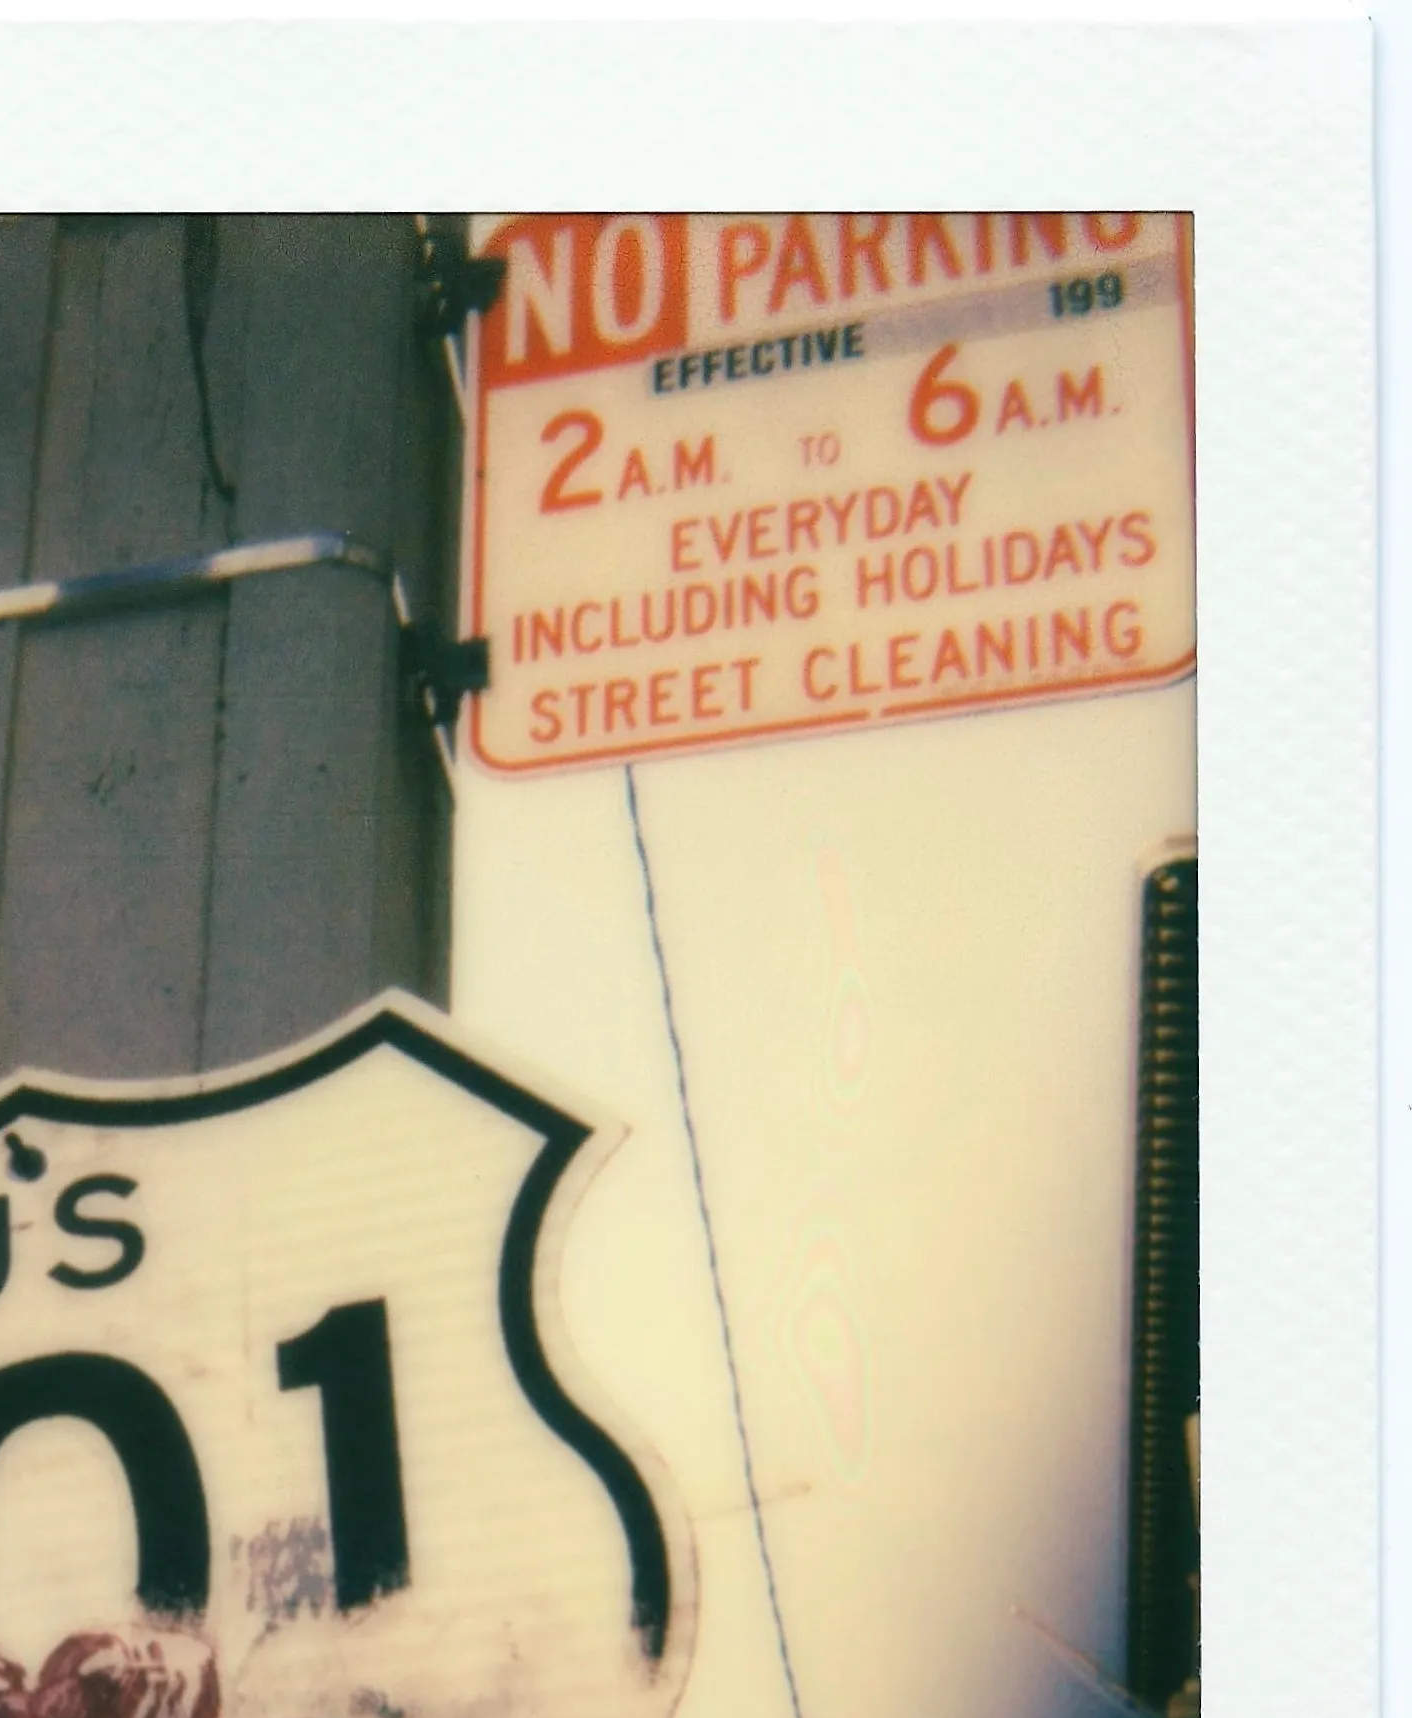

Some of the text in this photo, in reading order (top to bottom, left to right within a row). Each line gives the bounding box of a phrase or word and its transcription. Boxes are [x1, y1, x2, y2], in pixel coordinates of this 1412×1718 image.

[504, 213, 665, 364] NO
[653, 270, 1125, 393] EFFECTIVE 199
[801, 434, 841, 467] TO
[994, 362, 1122, 437] A.M.
[512, 511, 1157, 664] INCLUDING HOLIDAYS
[670, 472, 974, 573] EVERYDAY
[529, 655, 762, 744] STREET
[801, 602, 1145, 702] CLEANING
